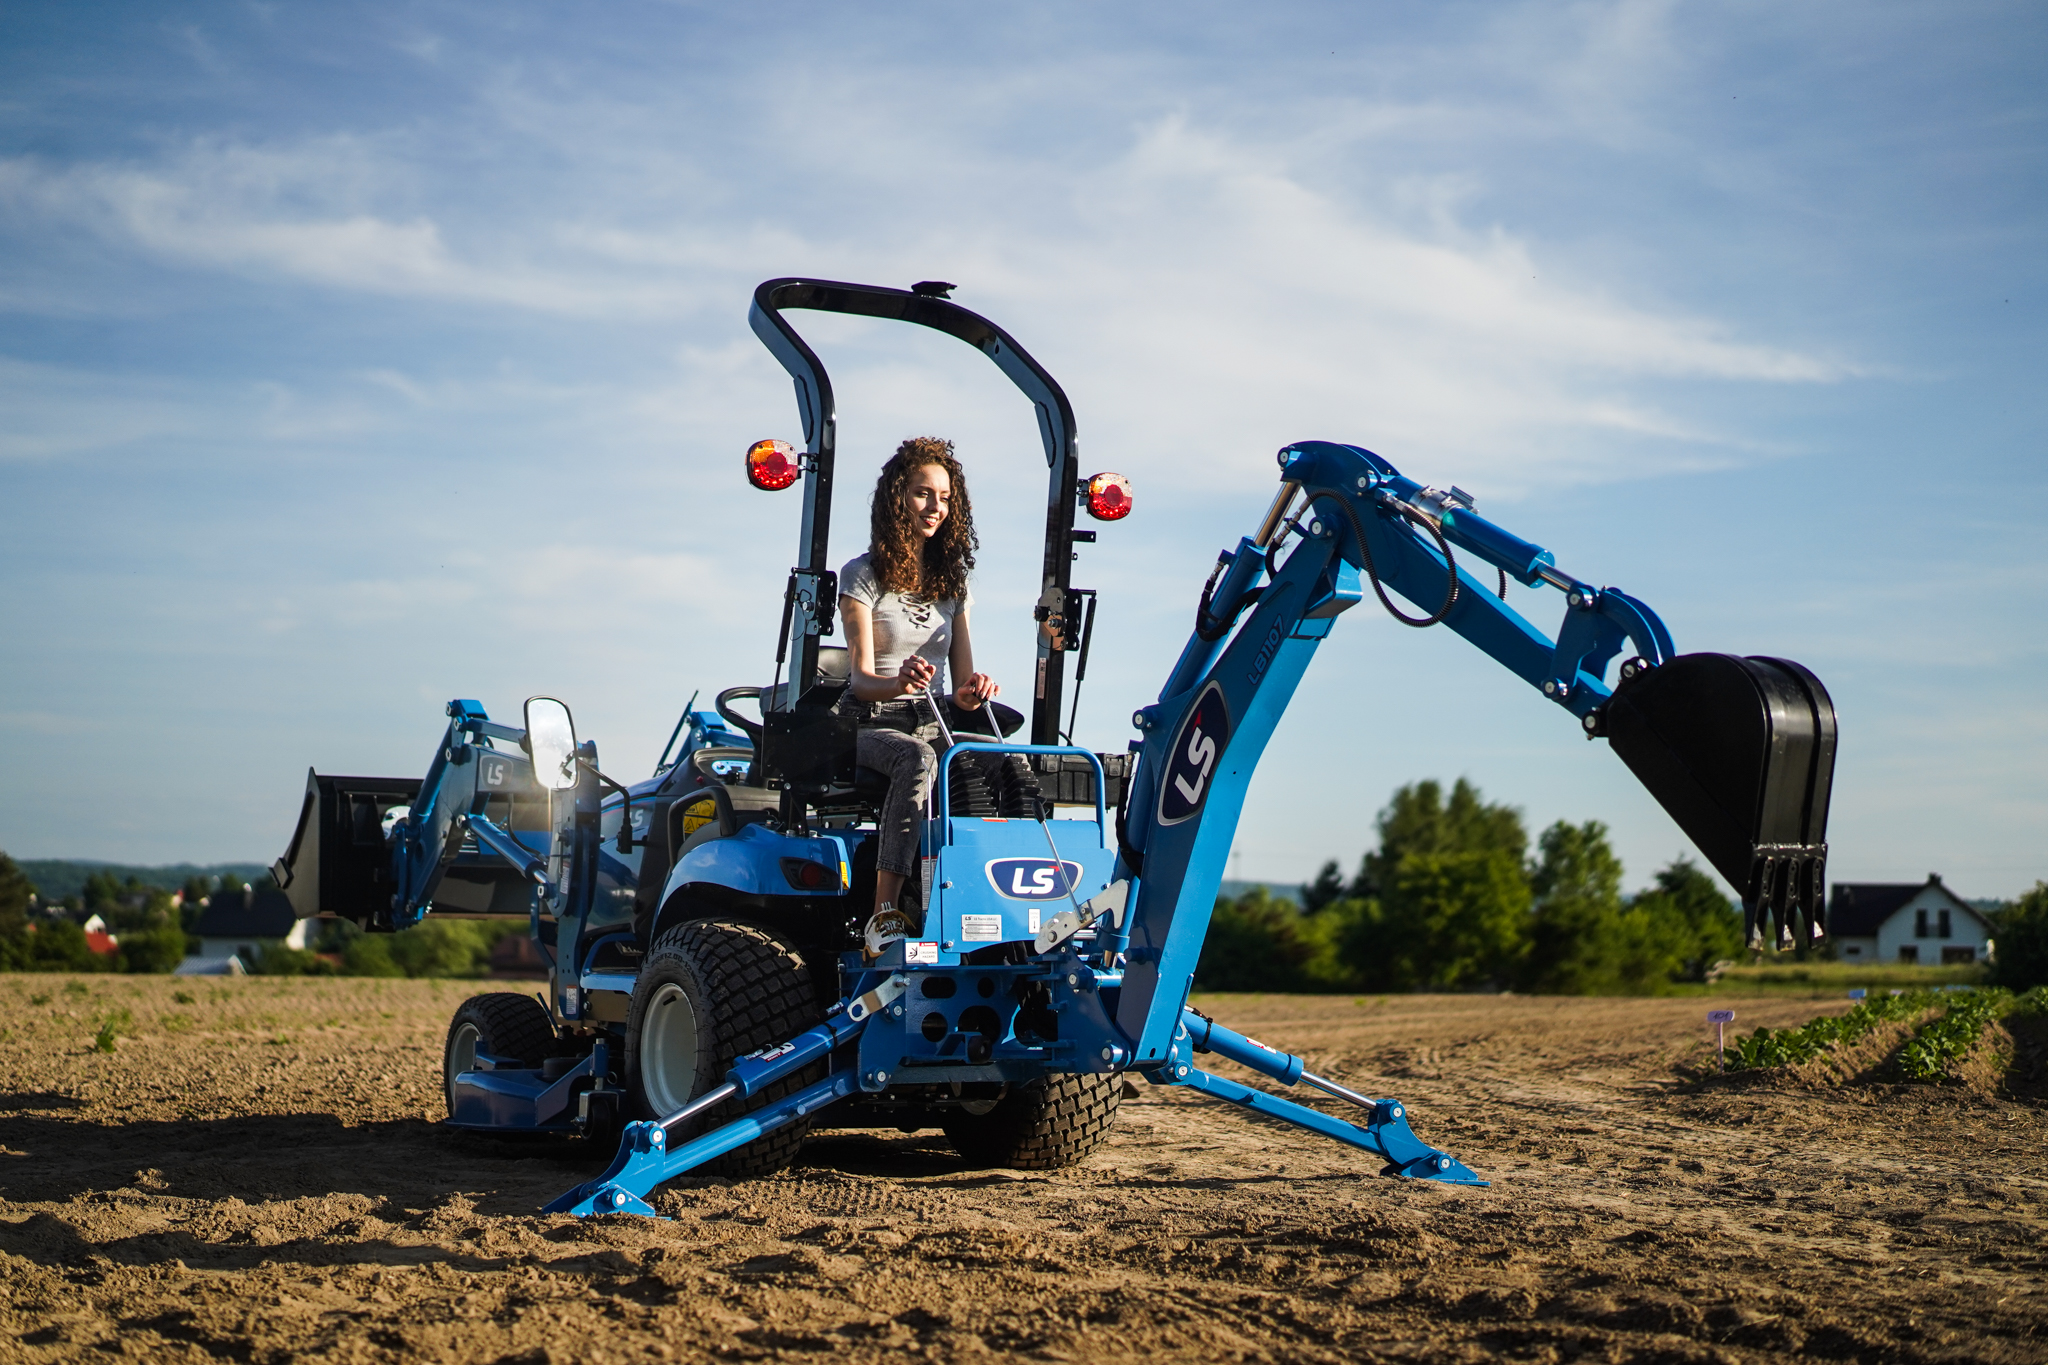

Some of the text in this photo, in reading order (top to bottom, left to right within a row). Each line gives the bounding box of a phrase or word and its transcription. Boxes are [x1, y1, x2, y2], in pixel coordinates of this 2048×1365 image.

[1247, 614, 1284, 685] LB1107
[488, 763, 504, 785] LS
[1175, 726, 1216, 804] LS
[1012, 867, 1055, 894] LS
